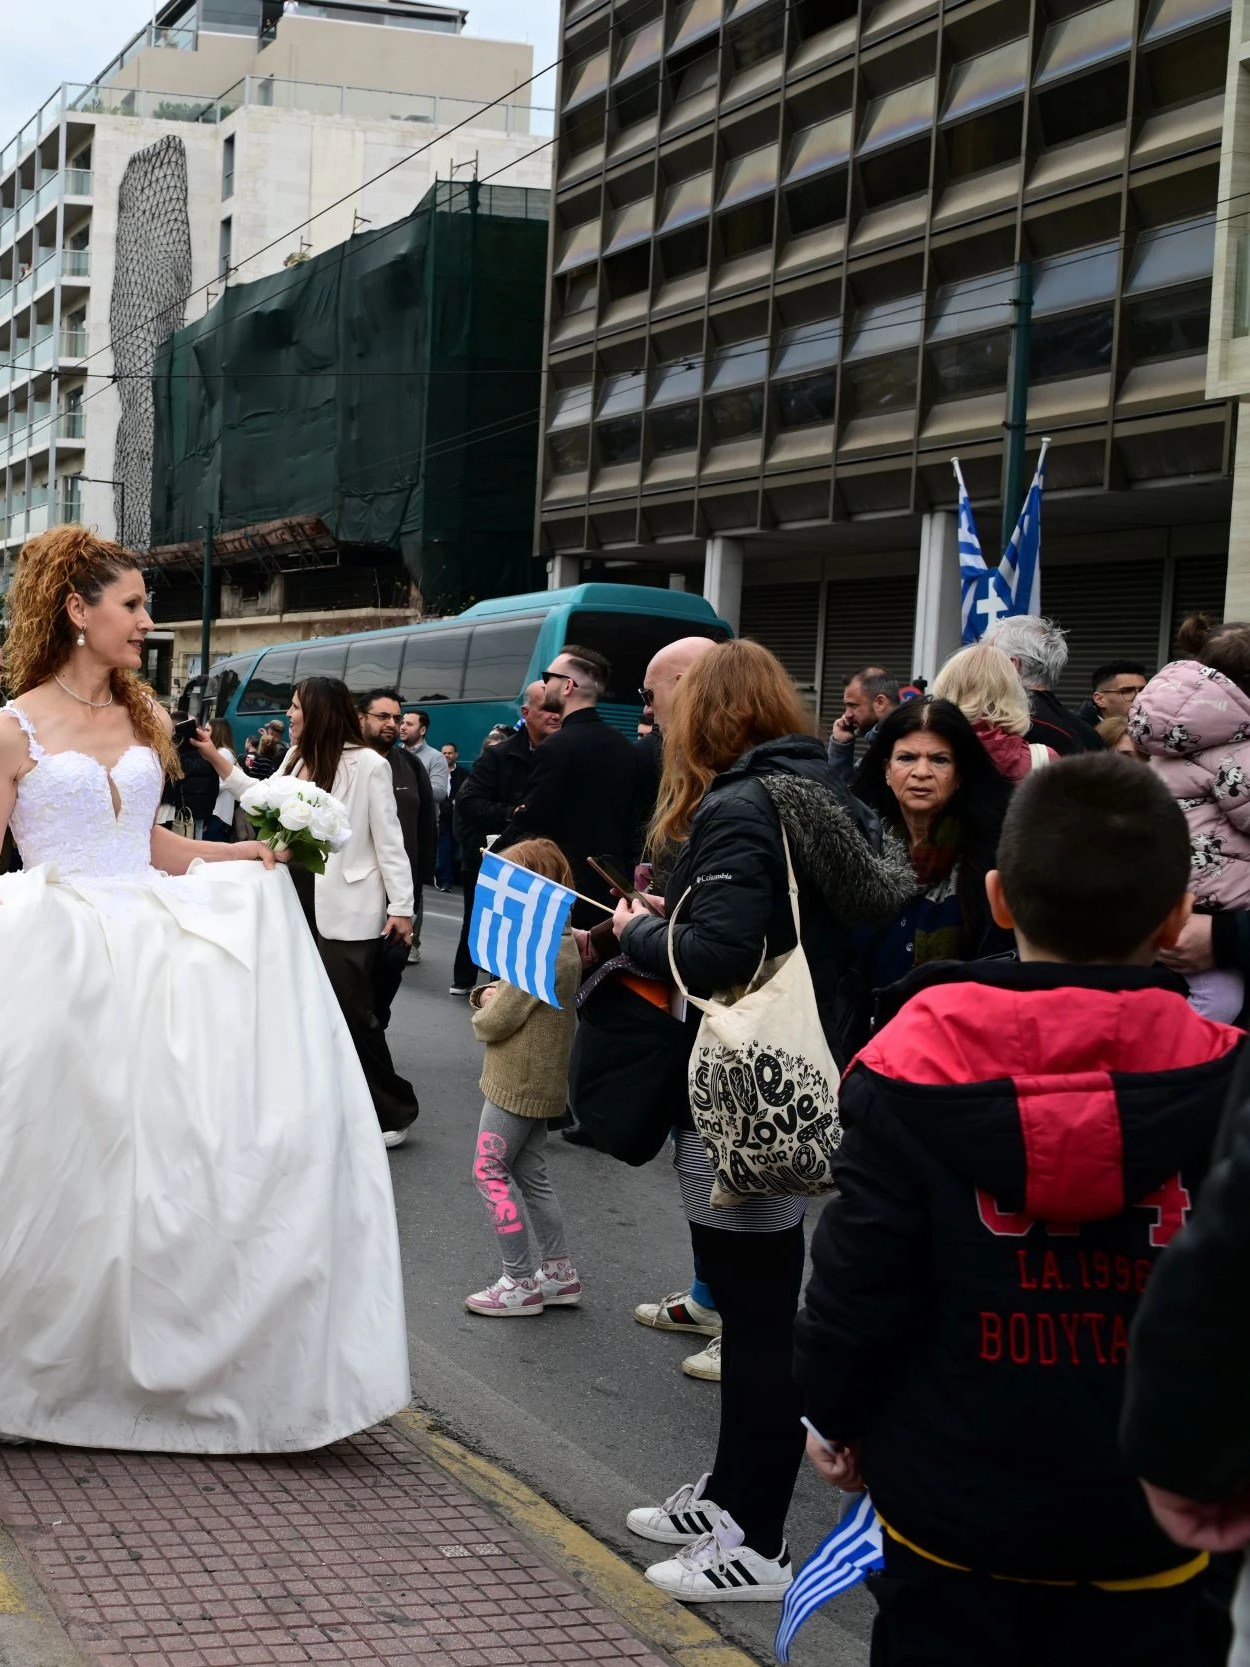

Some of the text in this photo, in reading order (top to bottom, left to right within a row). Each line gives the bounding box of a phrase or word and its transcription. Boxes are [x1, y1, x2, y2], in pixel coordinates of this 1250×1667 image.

[701, 872, 733, 882] Columbia
[697, 1117, 724, 1136] and
[747, 1150, 789, 1166] YOUR
